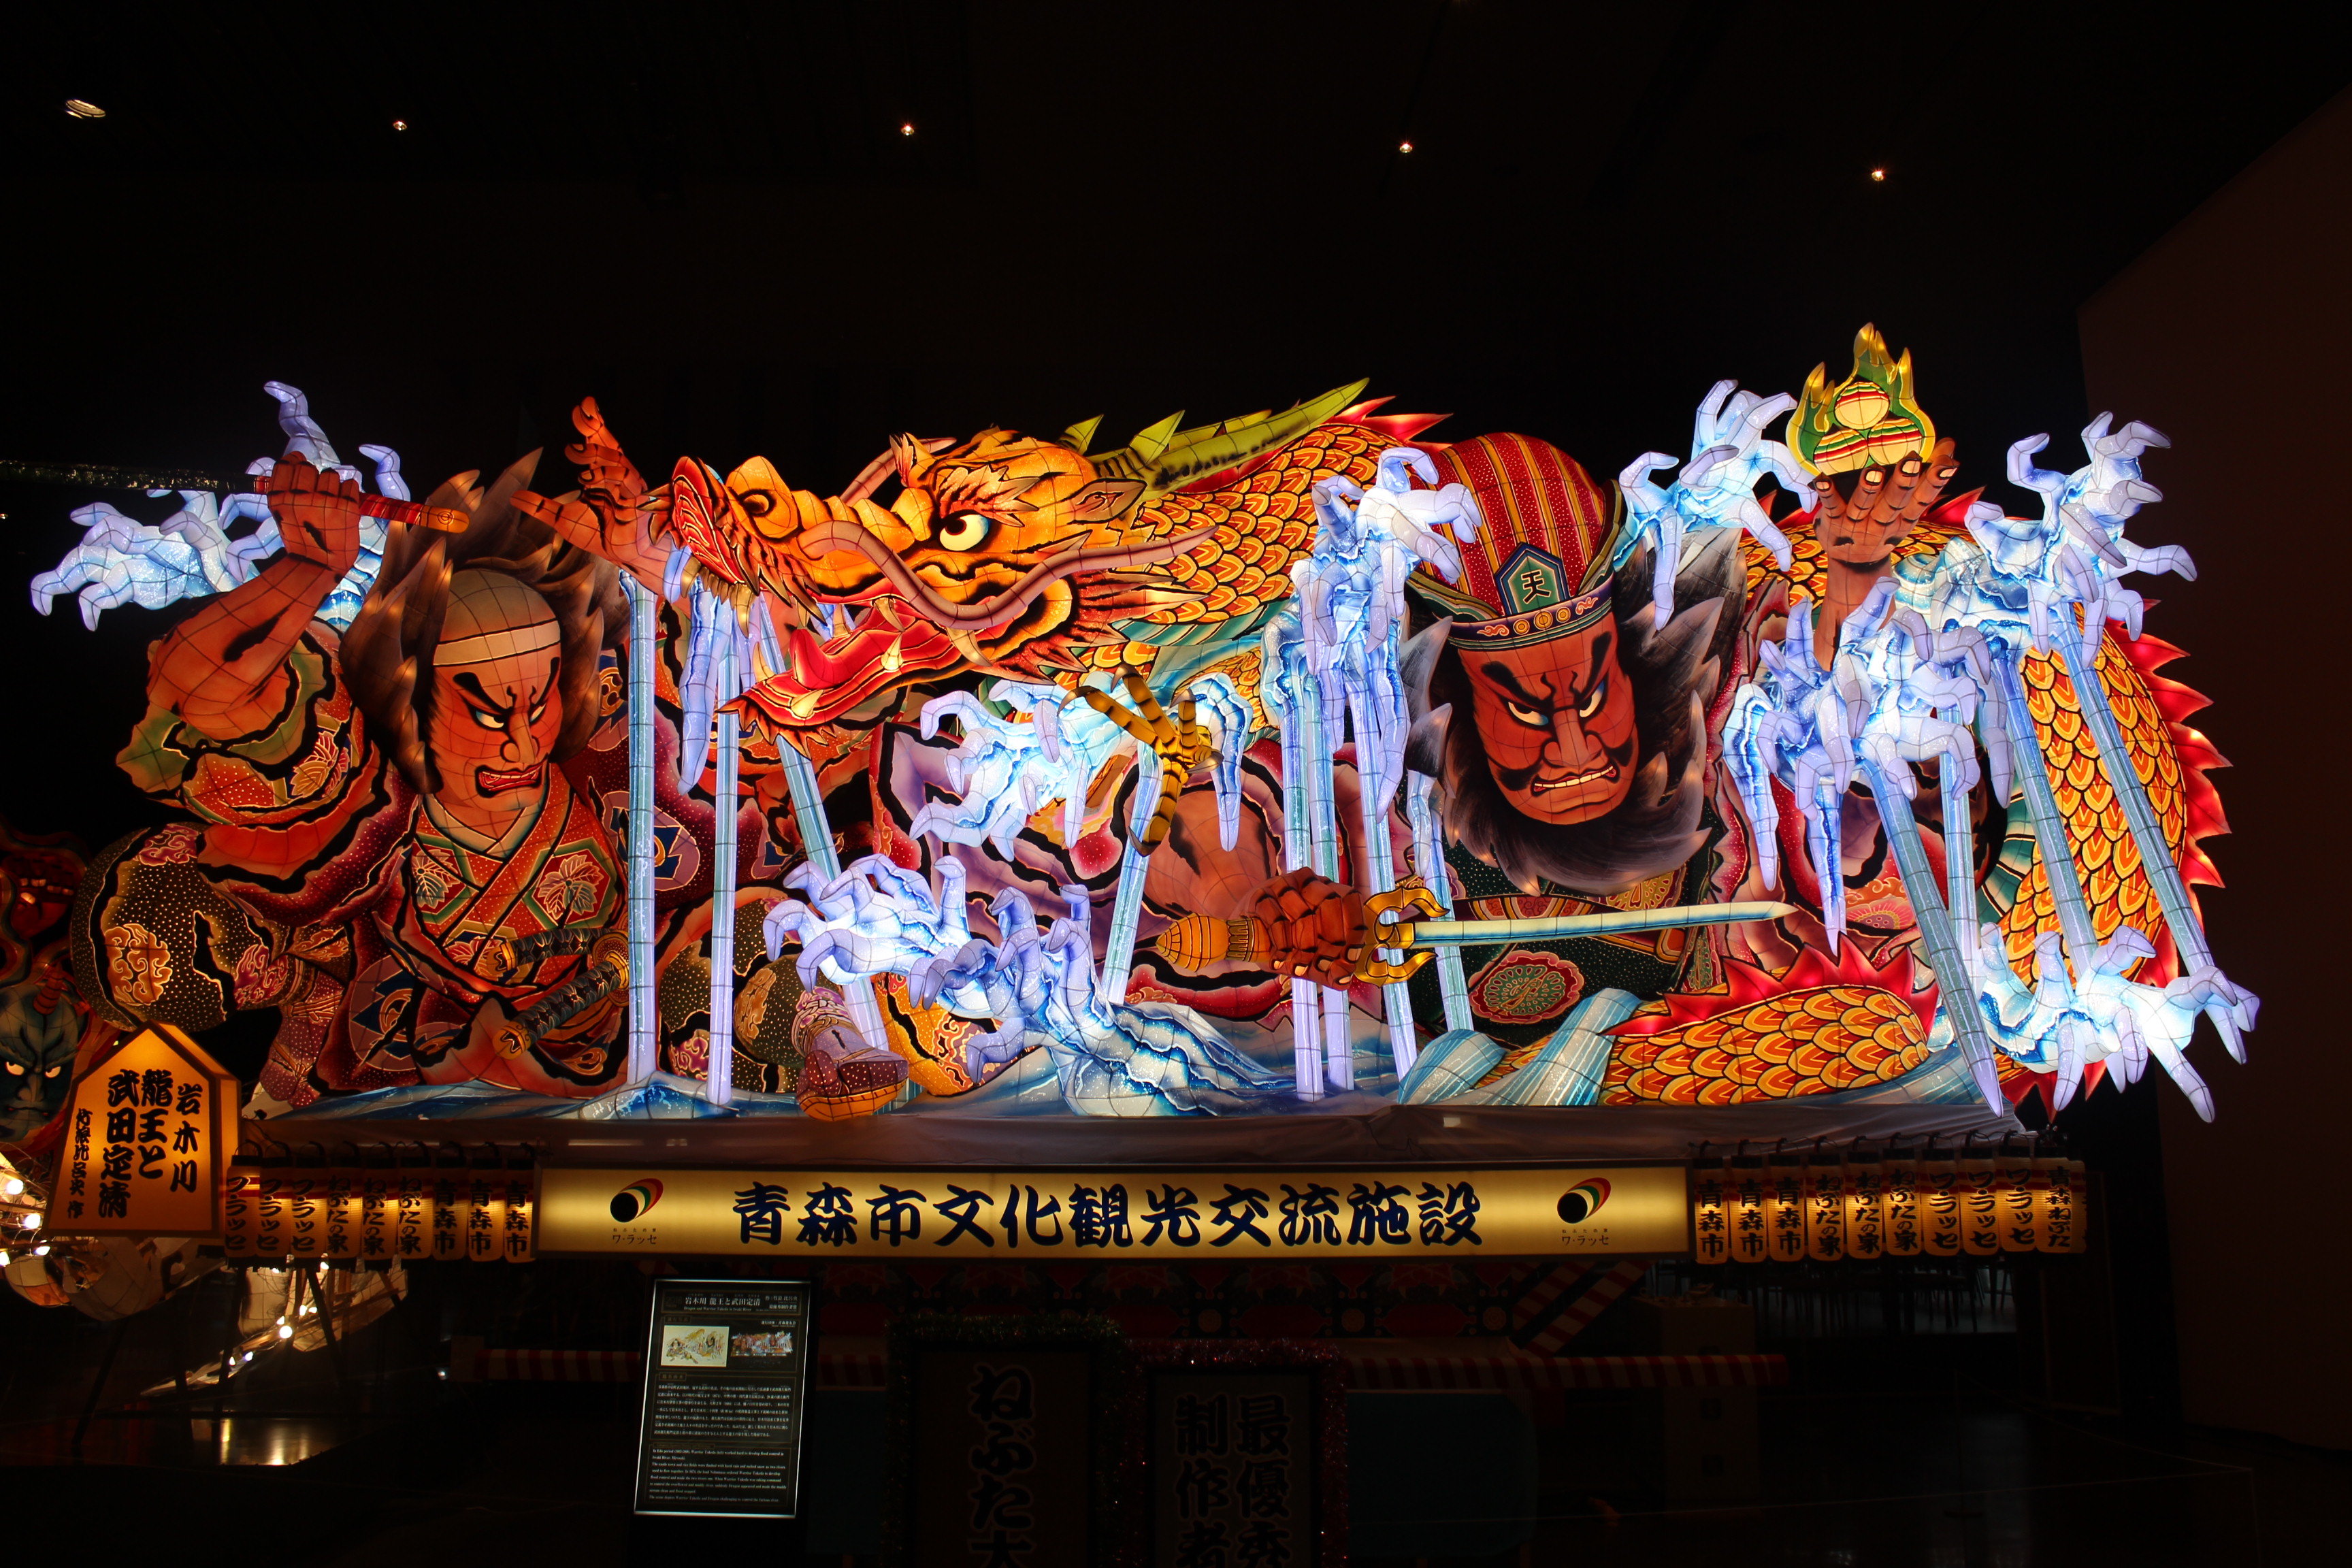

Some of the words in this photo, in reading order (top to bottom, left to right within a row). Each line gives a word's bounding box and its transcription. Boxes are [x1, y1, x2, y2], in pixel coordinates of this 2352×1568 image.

[1521, 568, 1552, 604] 天
[98, 1068, 140, 1218] 武田定清
[137, 1068, 174, 1179] 龍王と
[170, 1083, 203, 1193] 岩木川
[327, 1175, 351, 1254] ねぶたの家
[363, 1177, 387, 1255] ねぶたの家
[398, 1175, 423, 1255] ねぶたの家
[434, 1178, 458, 1255] 青森市
[470, 1179, 493, 1256] 青森市
[505, 1180, 529, 1257] 青森市
[732, 1180, 1483, 1249] 青森市文化観光交流施設
[1698, 1179, 1725, 1258] 青森市
[1737, 1178, 1764, 1257] 青森市
[1774, 1176, 1801, 1256] 青森市
[1815, 1174, 1842, 1257] ねぶたの家
[1855, 1171, 1882, 1254] ねぶたの家
[1889, 1169, 1918, 1251] ねぶたの家
[2045, 1166, 2072, 1248] 青森ねぶた
[685, 1296, 706, 1305] 岩木川
[1175, 1394, 1230, 1568] 制作者
[1237, 1394, 1291, 1568] 最優秀
